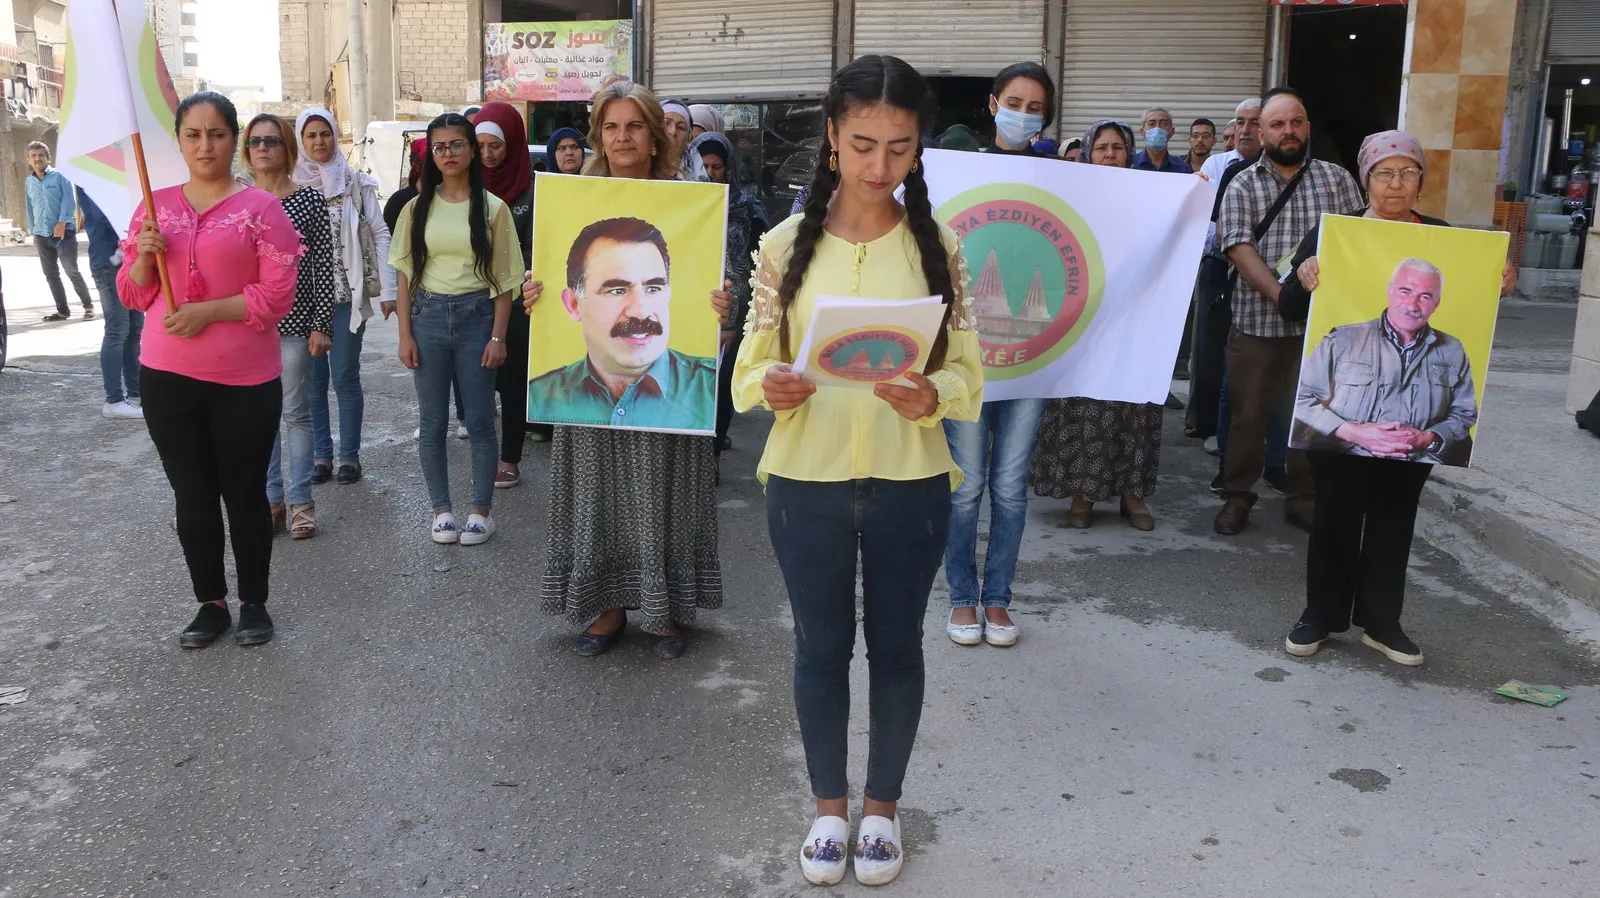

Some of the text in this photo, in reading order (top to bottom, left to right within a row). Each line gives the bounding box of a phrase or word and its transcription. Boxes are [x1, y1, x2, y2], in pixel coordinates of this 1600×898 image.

[512, 31, 556, 49] SOZ
[567, 29, 607, 48] سوز
[581, 70, 602, 79] تحويل
